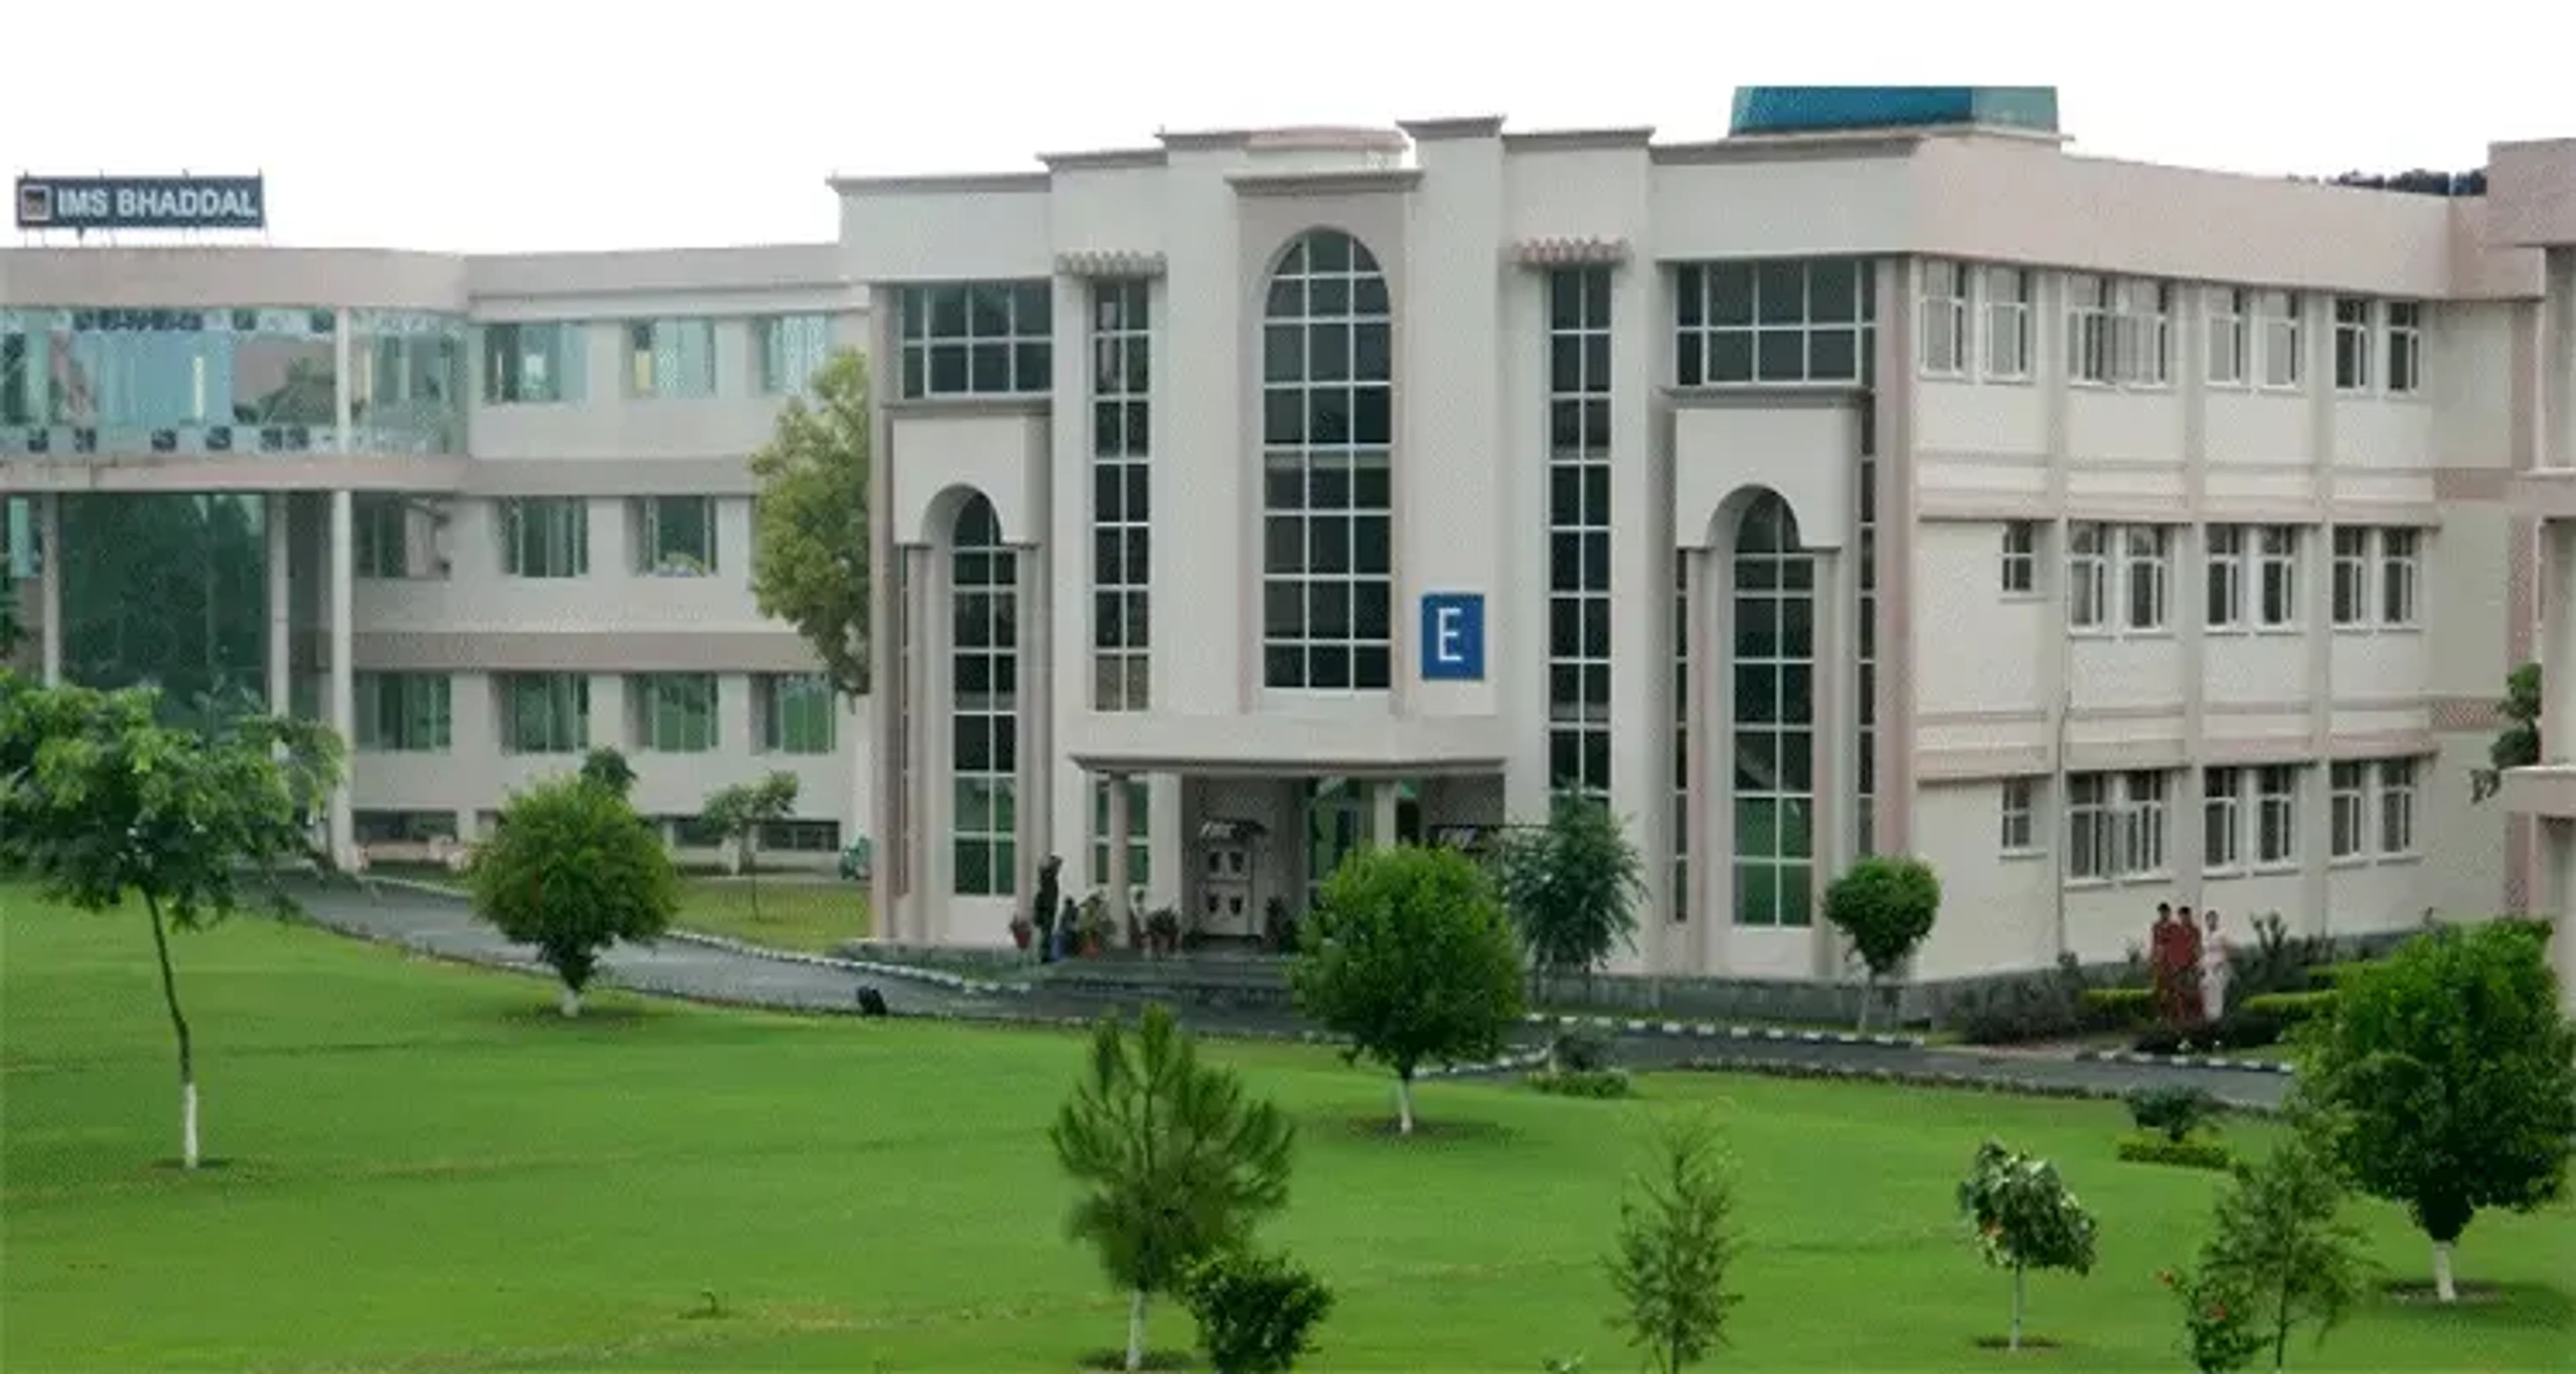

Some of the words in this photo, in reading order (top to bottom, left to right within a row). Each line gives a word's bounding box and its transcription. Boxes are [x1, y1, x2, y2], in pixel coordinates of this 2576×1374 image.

[58, 189, 108, 216] IMS
[117, 189, 258, 217] BHADDAL
[1438, 607, 1462, 661] E
